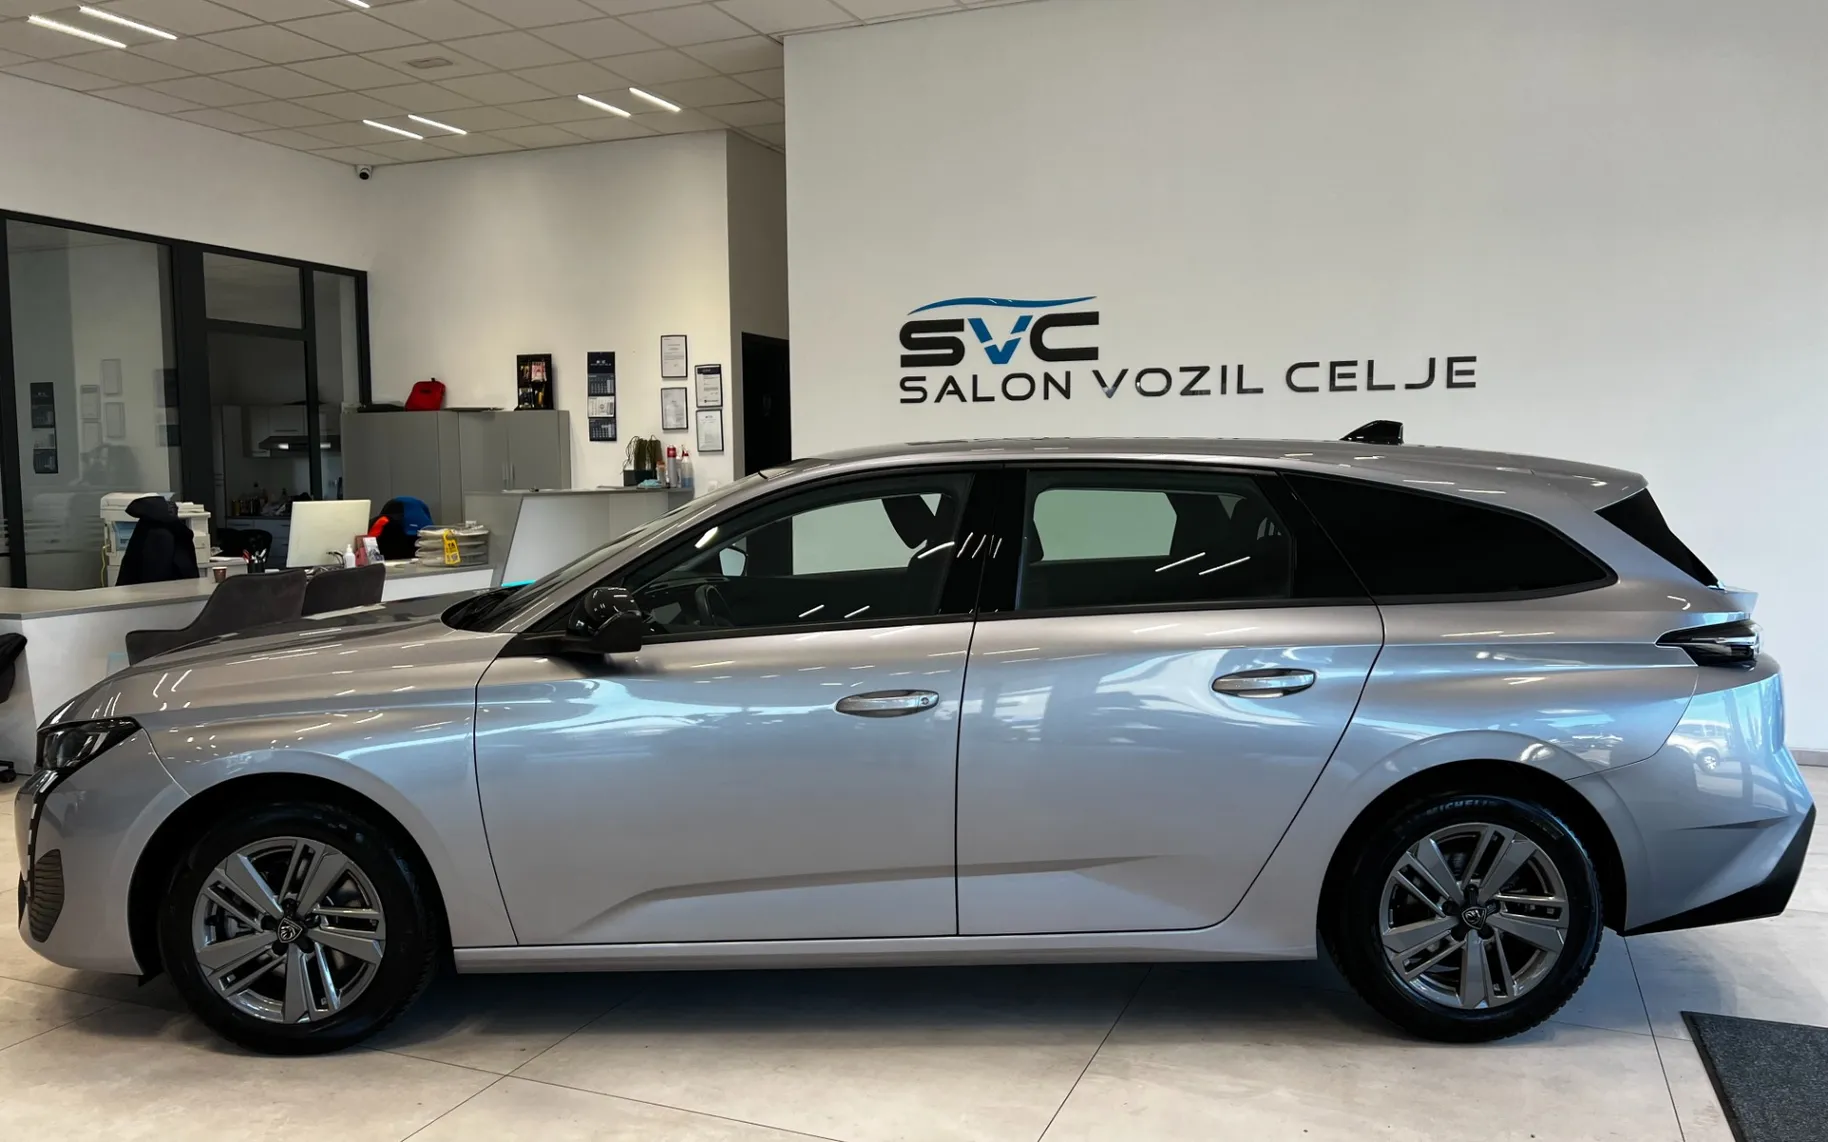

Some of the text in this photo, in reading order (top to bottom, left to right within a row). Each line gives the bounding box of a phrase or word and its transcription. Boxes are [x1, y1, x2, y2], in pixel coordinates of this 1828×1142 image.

[899, 311, 1100, 368] SVC
[899, 356, 1477, 404] SALON VOZIL CELJE
